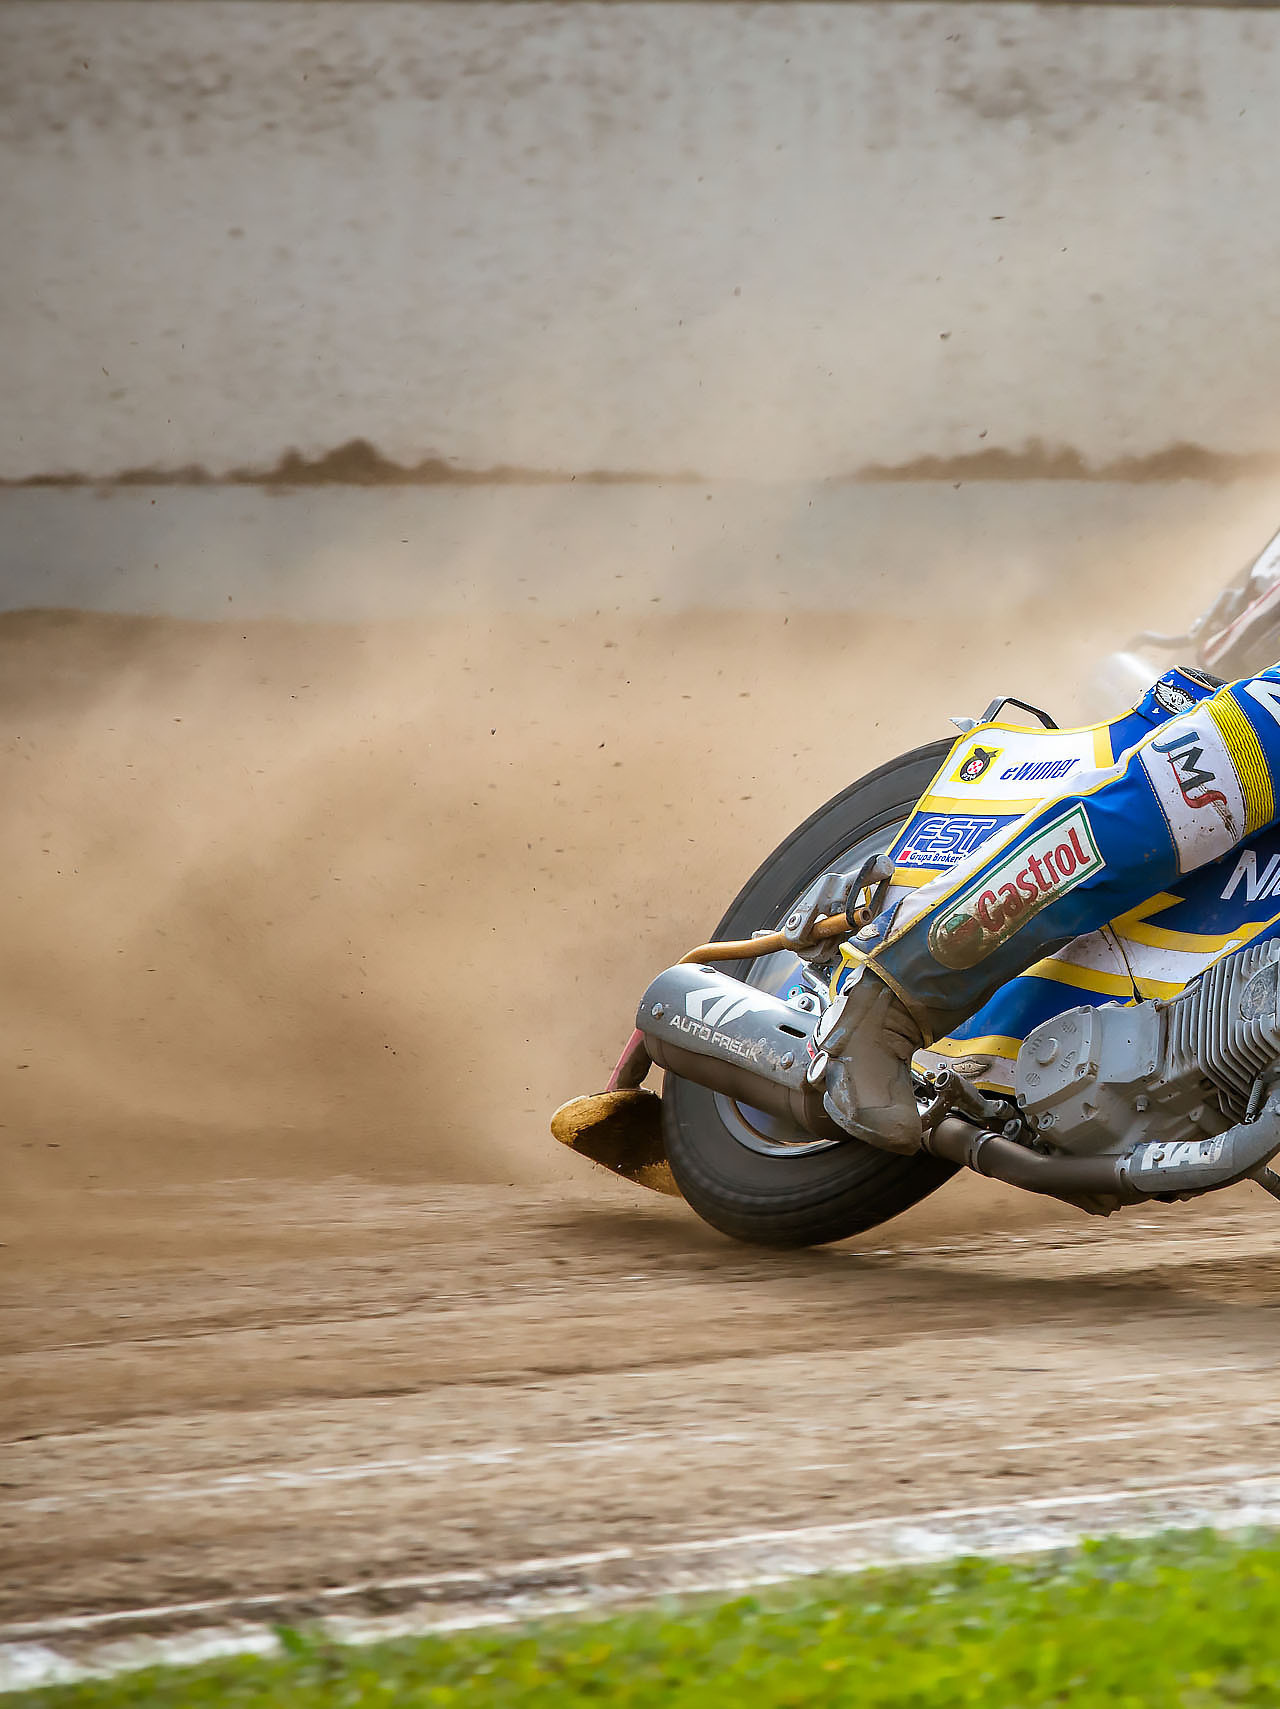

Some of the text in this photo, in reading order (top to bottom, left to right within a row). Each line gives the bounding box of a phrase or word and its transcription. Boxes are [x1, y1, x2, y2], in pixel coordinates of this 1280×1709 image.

[909, 852, 932, 863] Grupa
[977, 826, 1091, 932] Castrol
[669, 1014, 711, 1041] AUTO
